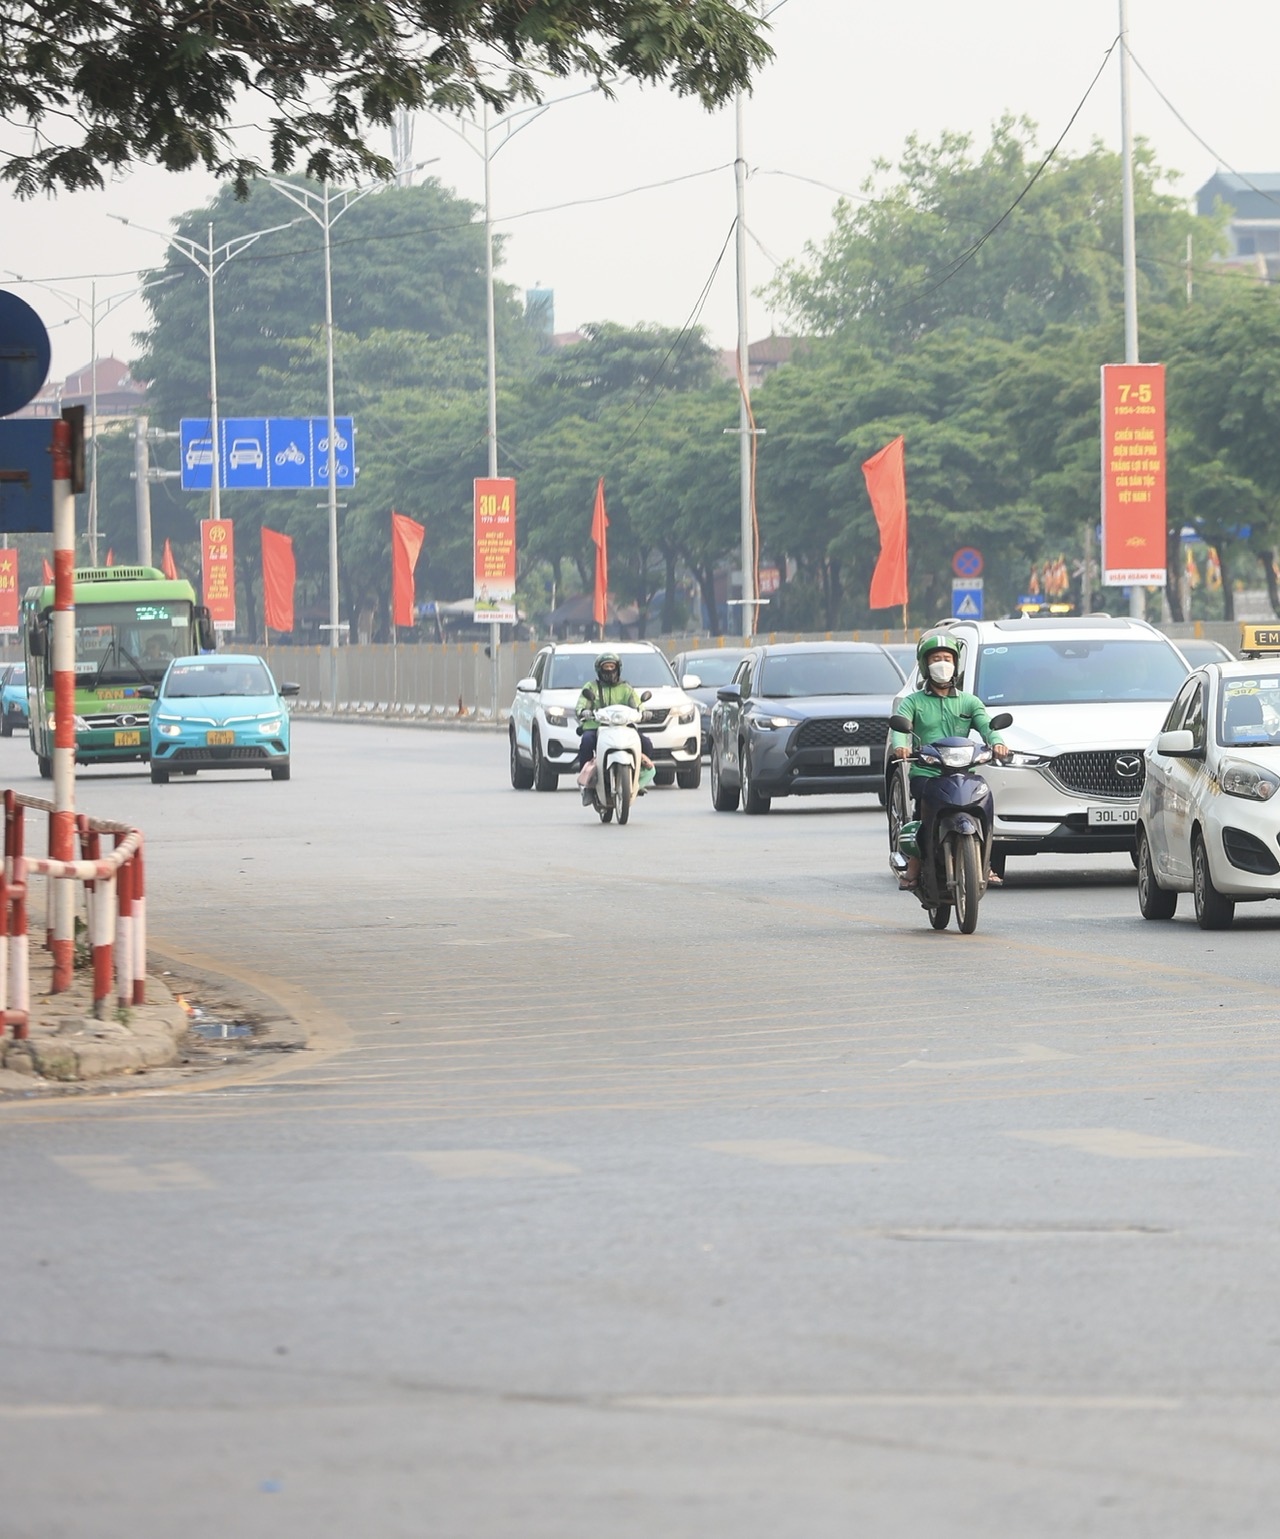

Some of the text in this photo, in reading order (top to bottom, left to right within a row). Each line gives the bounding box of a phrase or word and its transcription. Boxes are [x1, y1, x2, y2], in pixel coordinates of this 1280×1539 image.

[1117, 384, 1152, 403] 7-5
[844, 748, 860, 757] 30K
[1095, 810, 1138, 822] 30L-00
